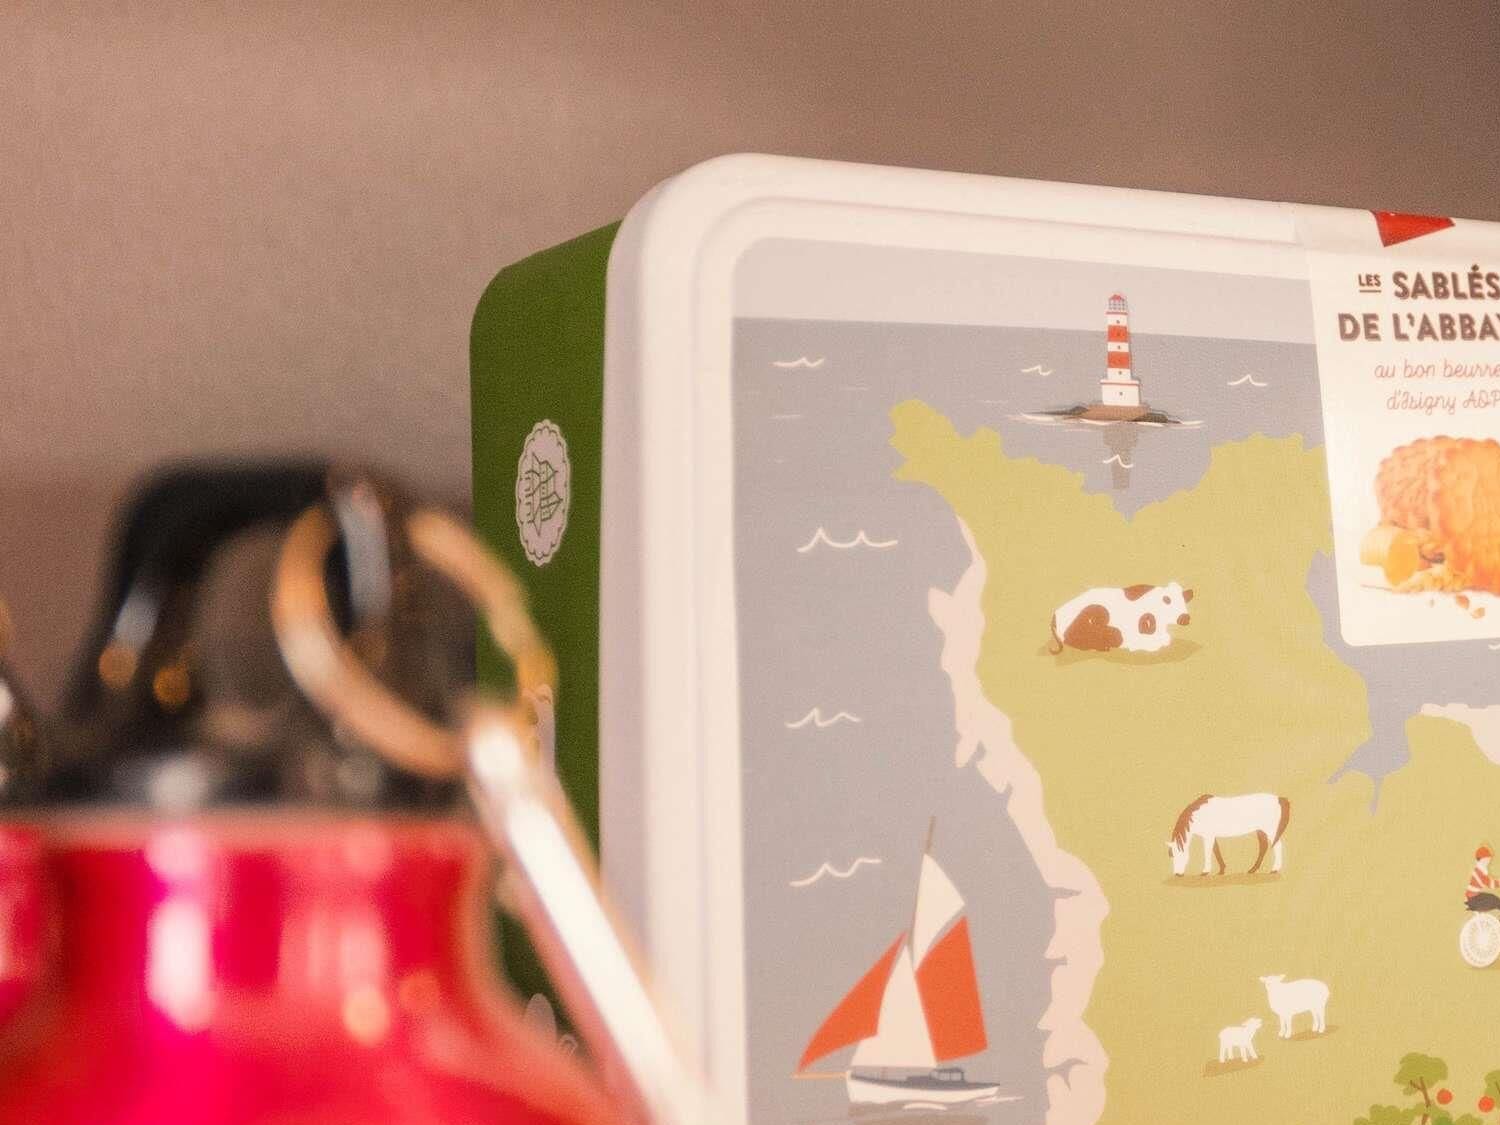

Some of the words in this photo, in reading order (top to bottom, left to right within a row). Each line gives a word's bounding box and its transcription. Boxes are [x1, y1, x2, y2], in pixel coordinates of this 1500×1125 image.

[1358, 273, 1382, 287] LES
[1337, 312, 1382, 342] DE
[1374, 364, 1396, 379] au
[1403, 358, 1436, 379] bon
